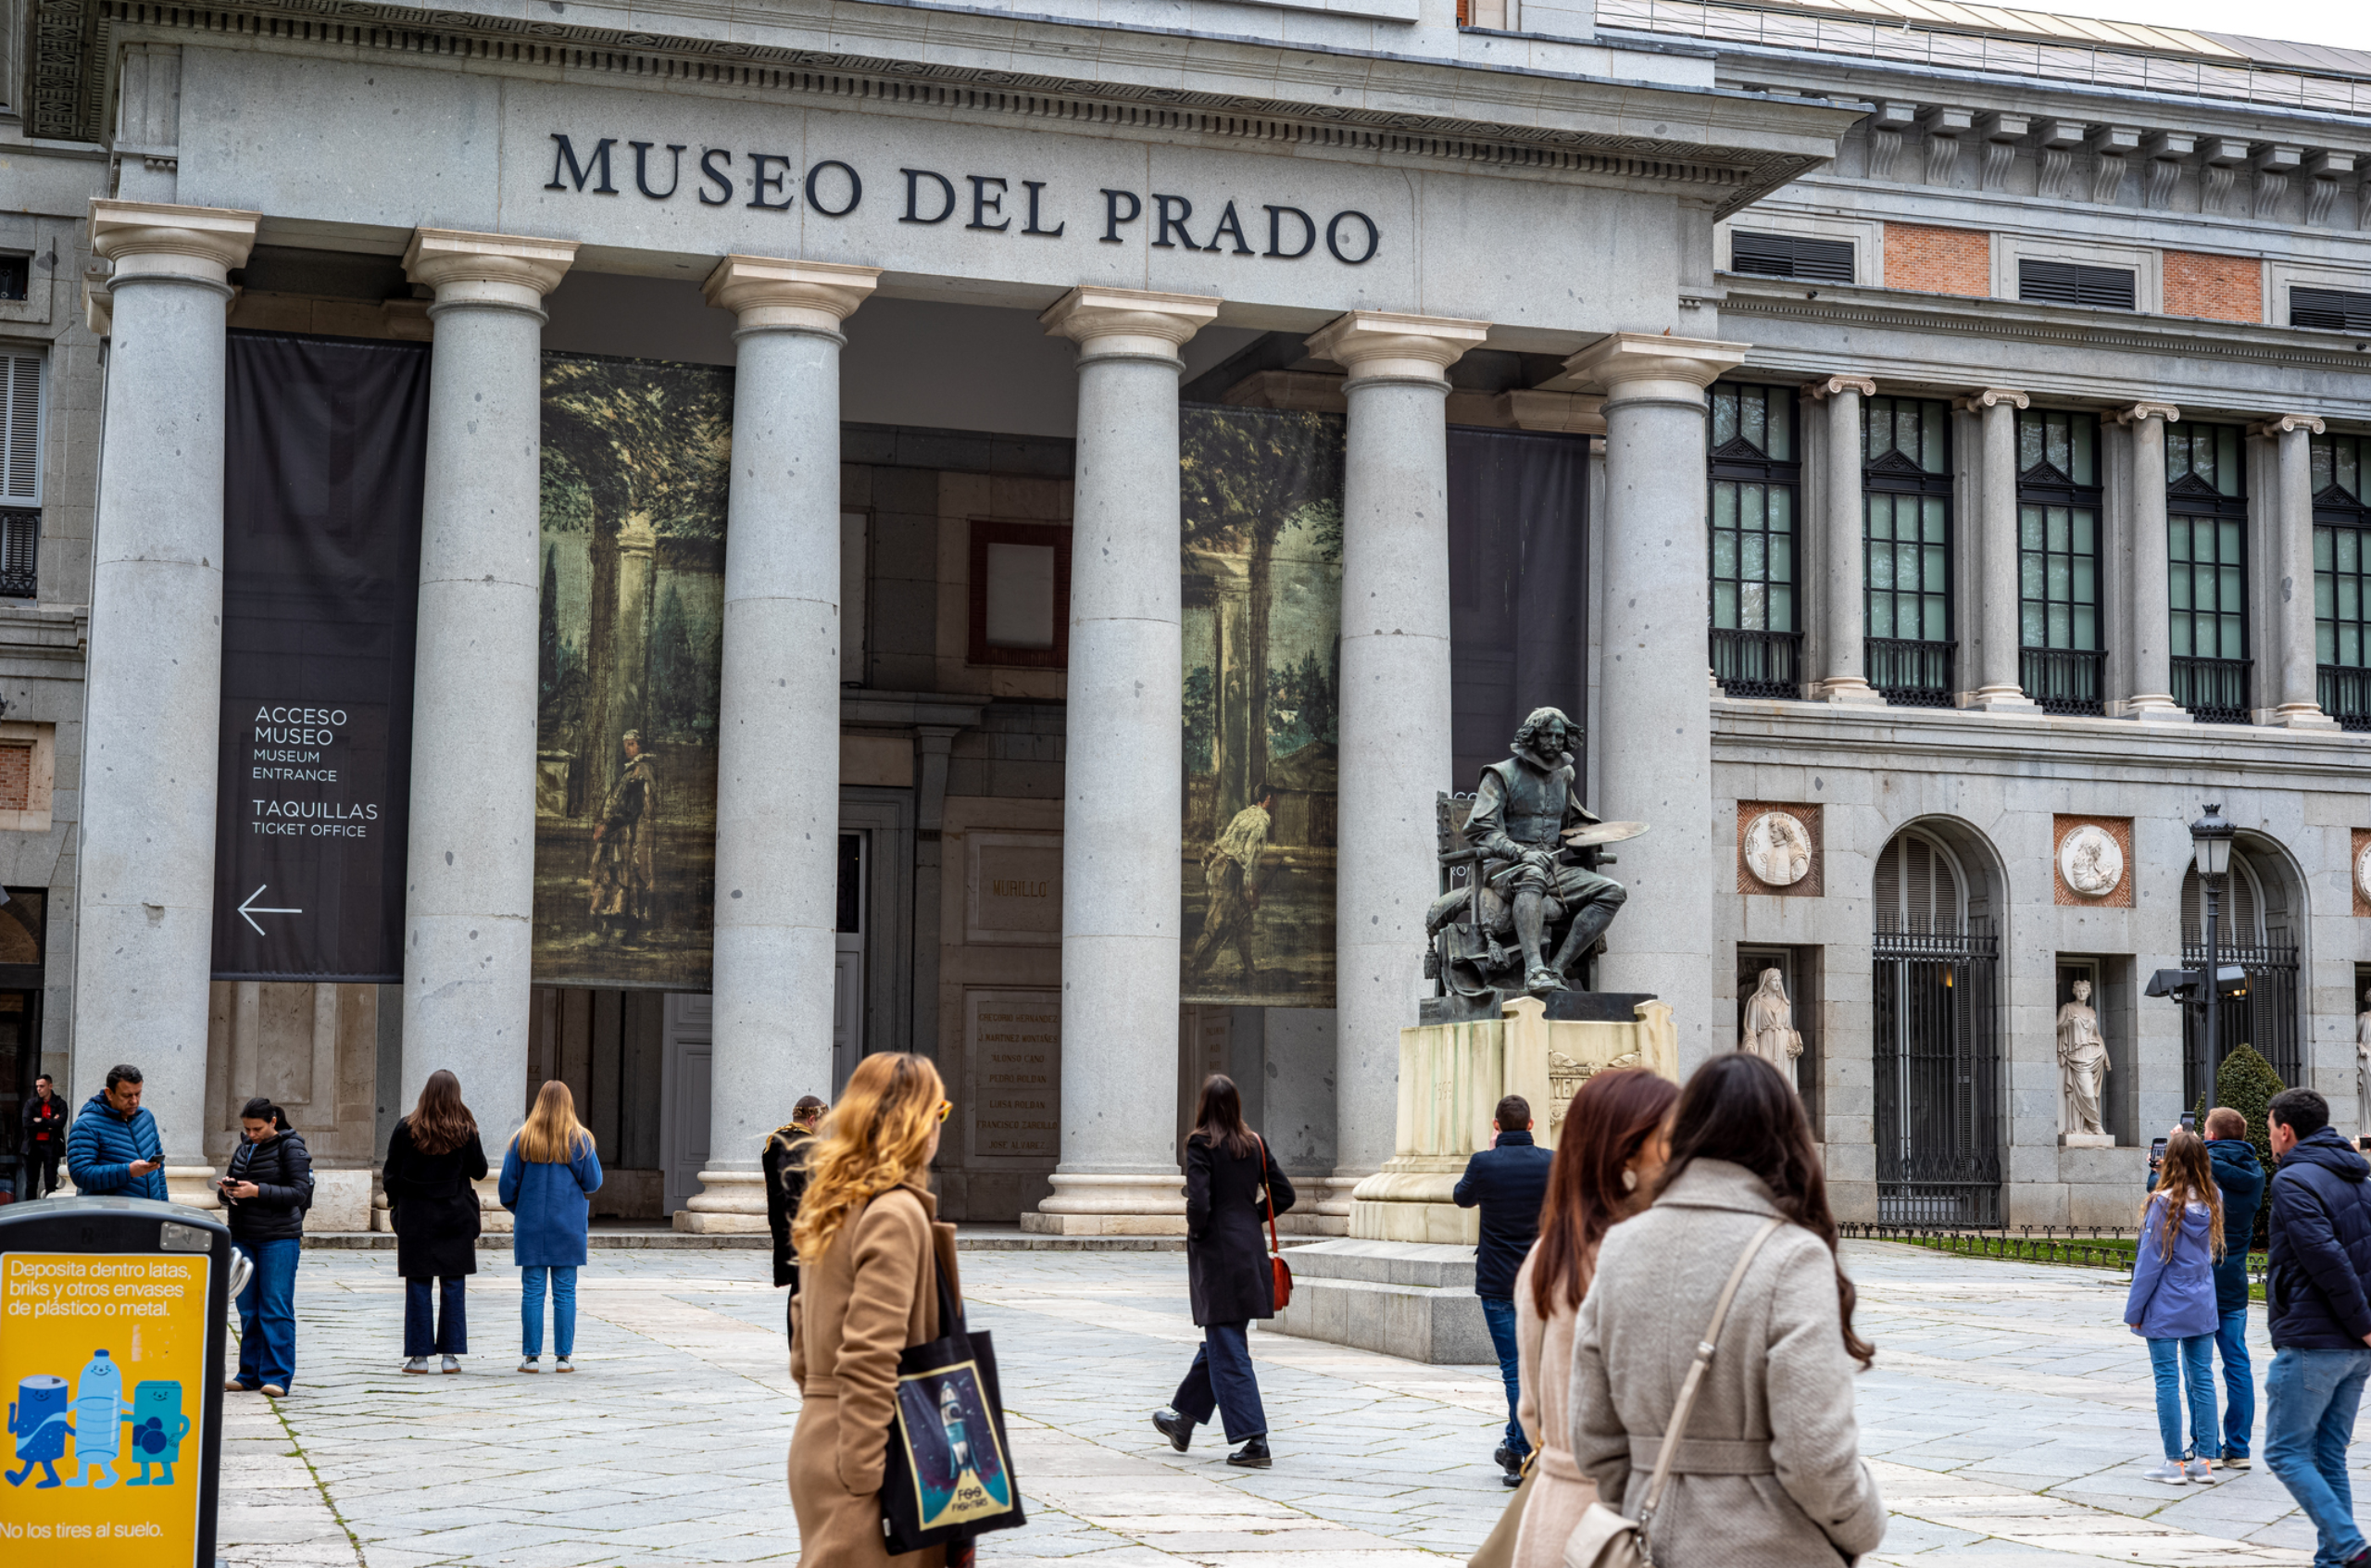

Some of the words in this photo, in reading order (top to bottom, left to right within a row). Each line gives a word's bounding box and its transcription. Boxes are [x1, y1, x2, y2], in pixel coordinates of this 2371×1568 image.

[544, 132, 861, 218] MUSEO
[898, 168, 1065, 237] DEL
[1099, 188, 1379, 265] PRADO
[255, 706, 347, 726] ACCESO
[255, 727, 333, 746] MUSEO
[254, 749, 320, 763] MUSEUM
[252, 767, 337, 783] ENTRANCE
[252, 799, 378, 821] TAQUILLAS
[252, 822, 306, 835] TICKET
[310, 823, 367, 837] OFFICE
[993, 880, 1047, 897] MURILLO
[979, 1012, 1013, 1022] GREGORIO
[1022, 1033, 1059, 1044] MONTAÑES
[992, 1054, 1022, 1063] ALONSO
[1024, 1055, 1045, 1063] CANO
[989, 1074, 1014, 1084] PEDRO
[1017, 1074, 1047, 1084] ROLDAN
[1434, 1081, 1451, 1100] 1599
[989, 1100, 1012, 1110] LUISA
[1014, 1100, 1046, 1110] ROLDAN
[976, 1120, 1019, 1129] FRANCISCO
[10, 1260, 86, 1279] Deposita
[90, 1261, 145, 1278] dentro
[148, 1261, 192, 1280] latas,
[9, 1278, 50, 1297] briks
[53, 1284, 64, 1301] y
[66, 1281, 110, 1297] otros
[113, 1284, 184, 1298] envases
[7, 1299, 31, 1316] de
[34, 1298, 102, 1319] plástico
[104, 1303, 117, 1316] o
[119, 1300, 170, 1317] metal.
[958, 1486, 982, 1501] FOO
[0, 1522, 23, 1538] No
[27, 1522, 52, 1538] los
[56, 1522, 93, 1538] tires
[95, 1522, 110, 1538] al
[114, 1521, 164, 1537] suelo.
